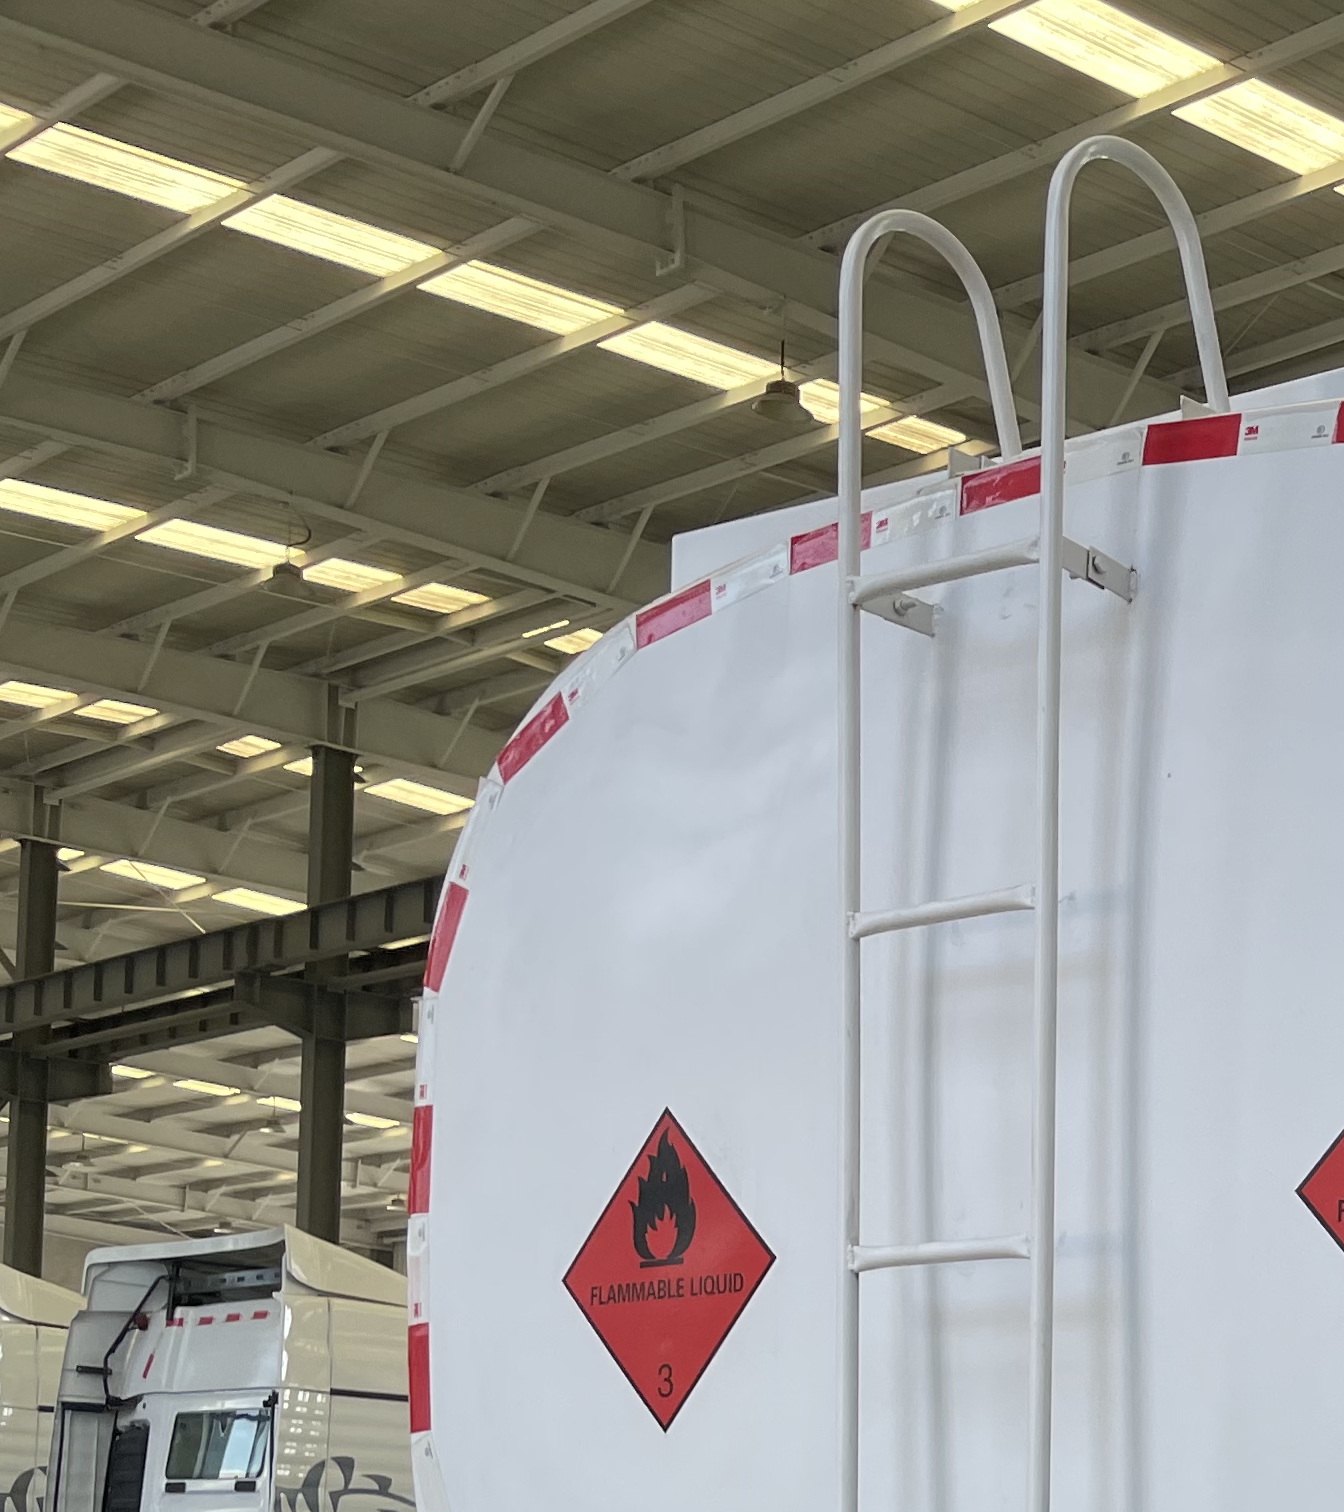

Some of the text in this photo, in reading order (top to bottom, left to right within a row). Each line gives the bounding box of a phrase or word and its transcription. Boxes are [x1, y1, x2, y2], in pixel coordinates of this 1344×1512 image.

[589, 1272, 744, 1306] FLAMMABLE LIQUID
[657, 1363, 674, 1398] 3
